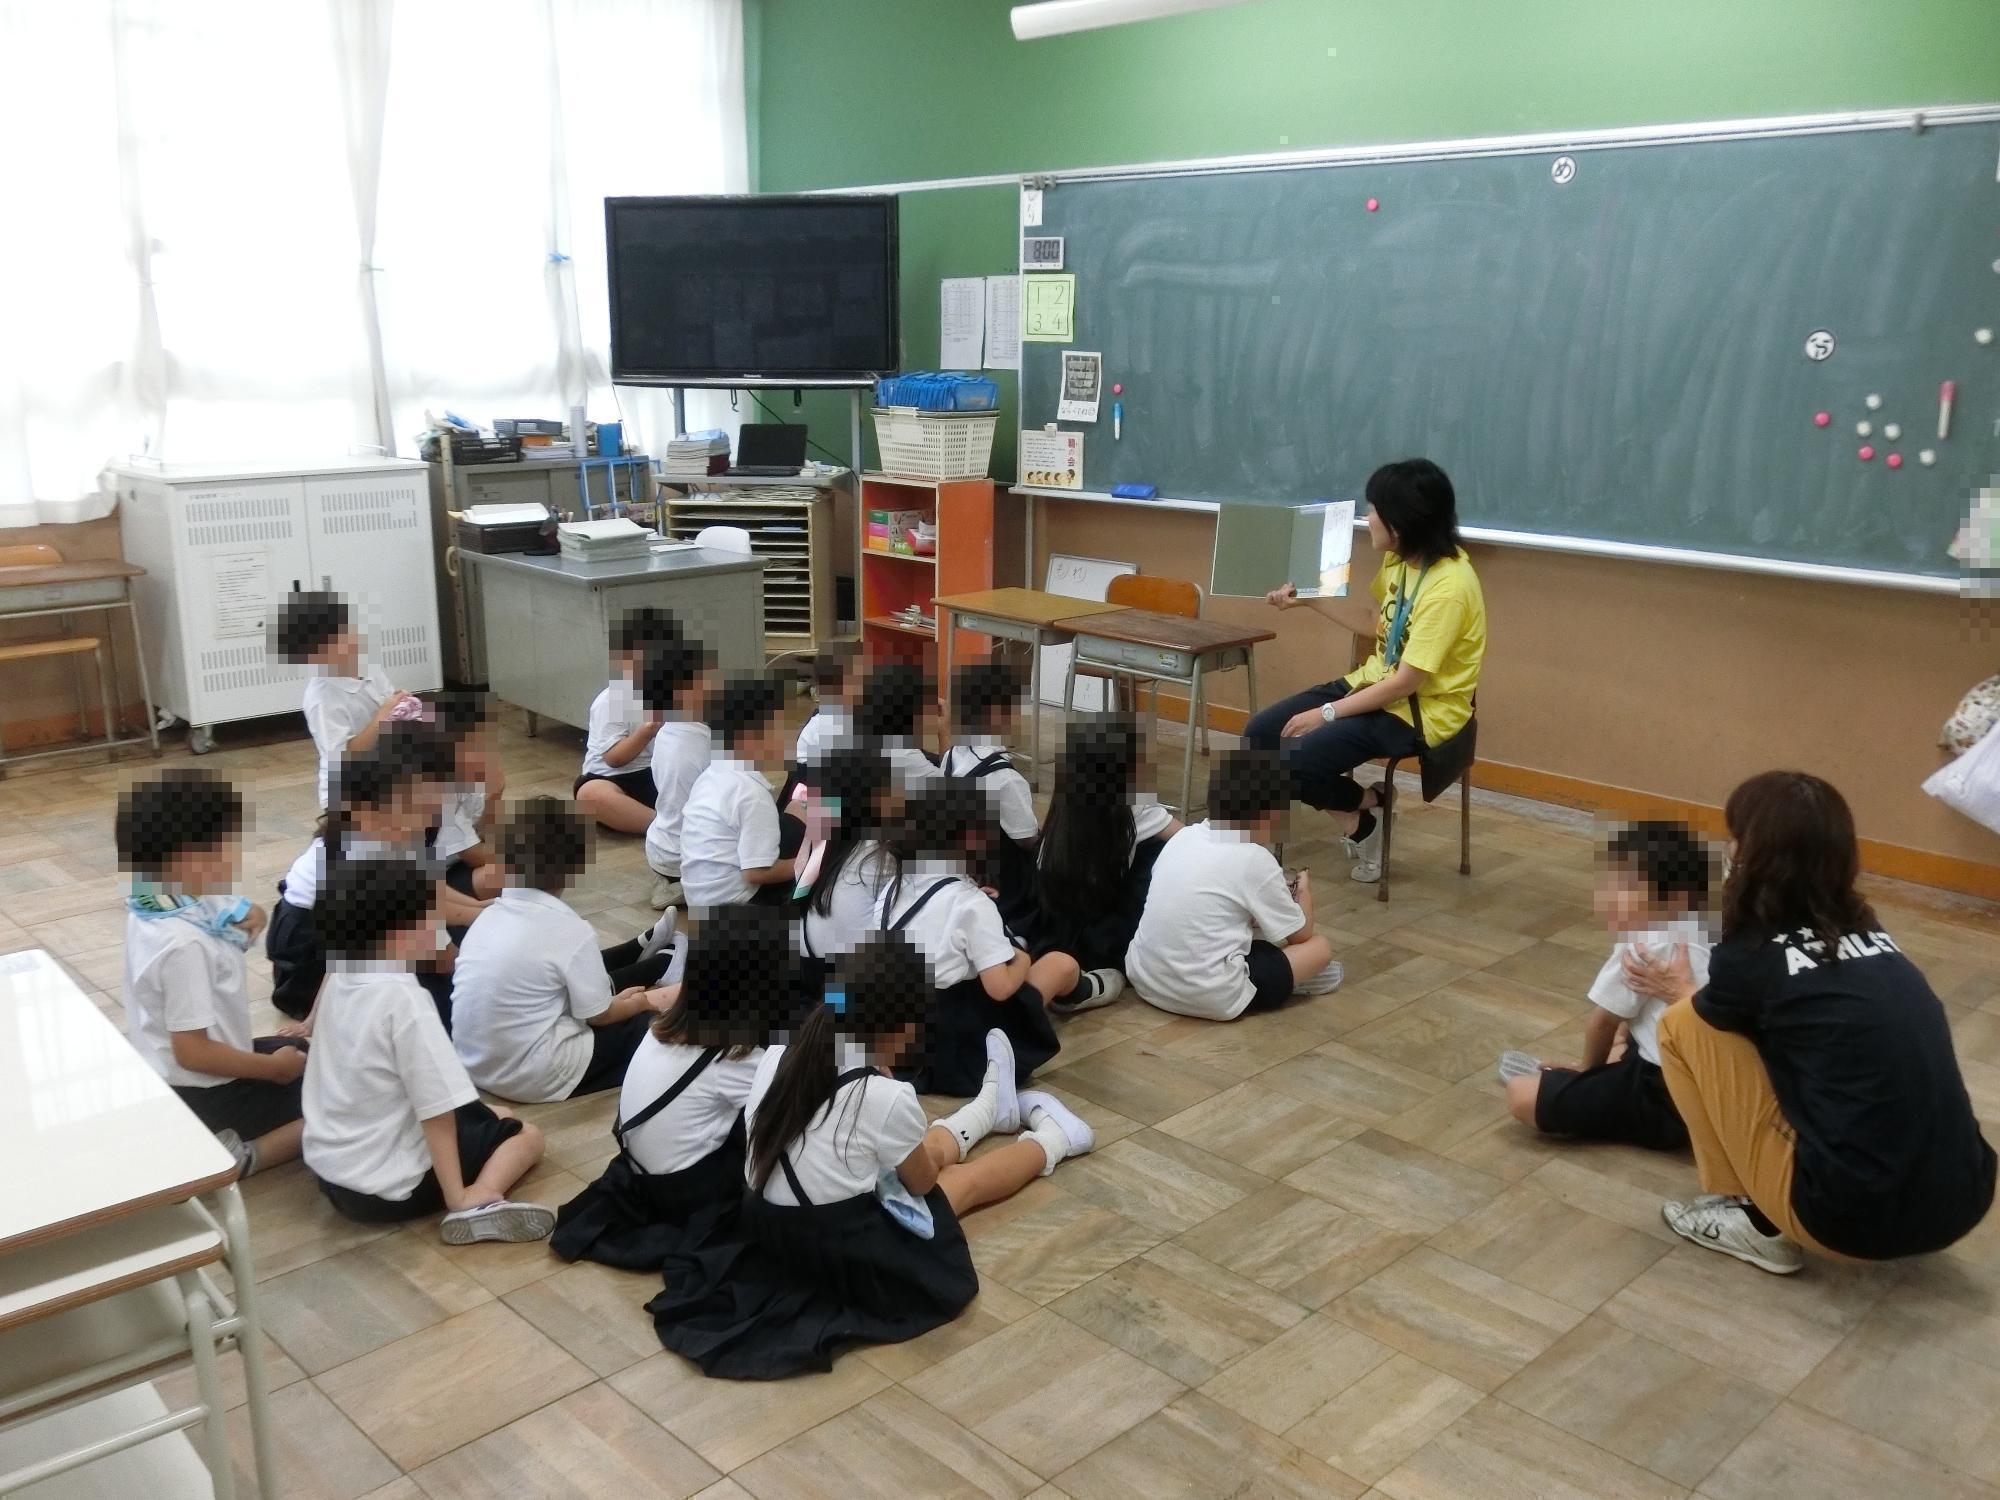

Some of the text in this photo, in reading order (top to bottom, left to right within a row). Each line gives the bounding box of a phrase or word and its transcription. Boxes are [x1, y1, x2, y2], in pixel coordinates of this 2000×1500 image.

[1554, 161, 1572, 179] め
[1054, 284, 1065, 305] 2
[1032, 313, 1065, 332] 3 4
